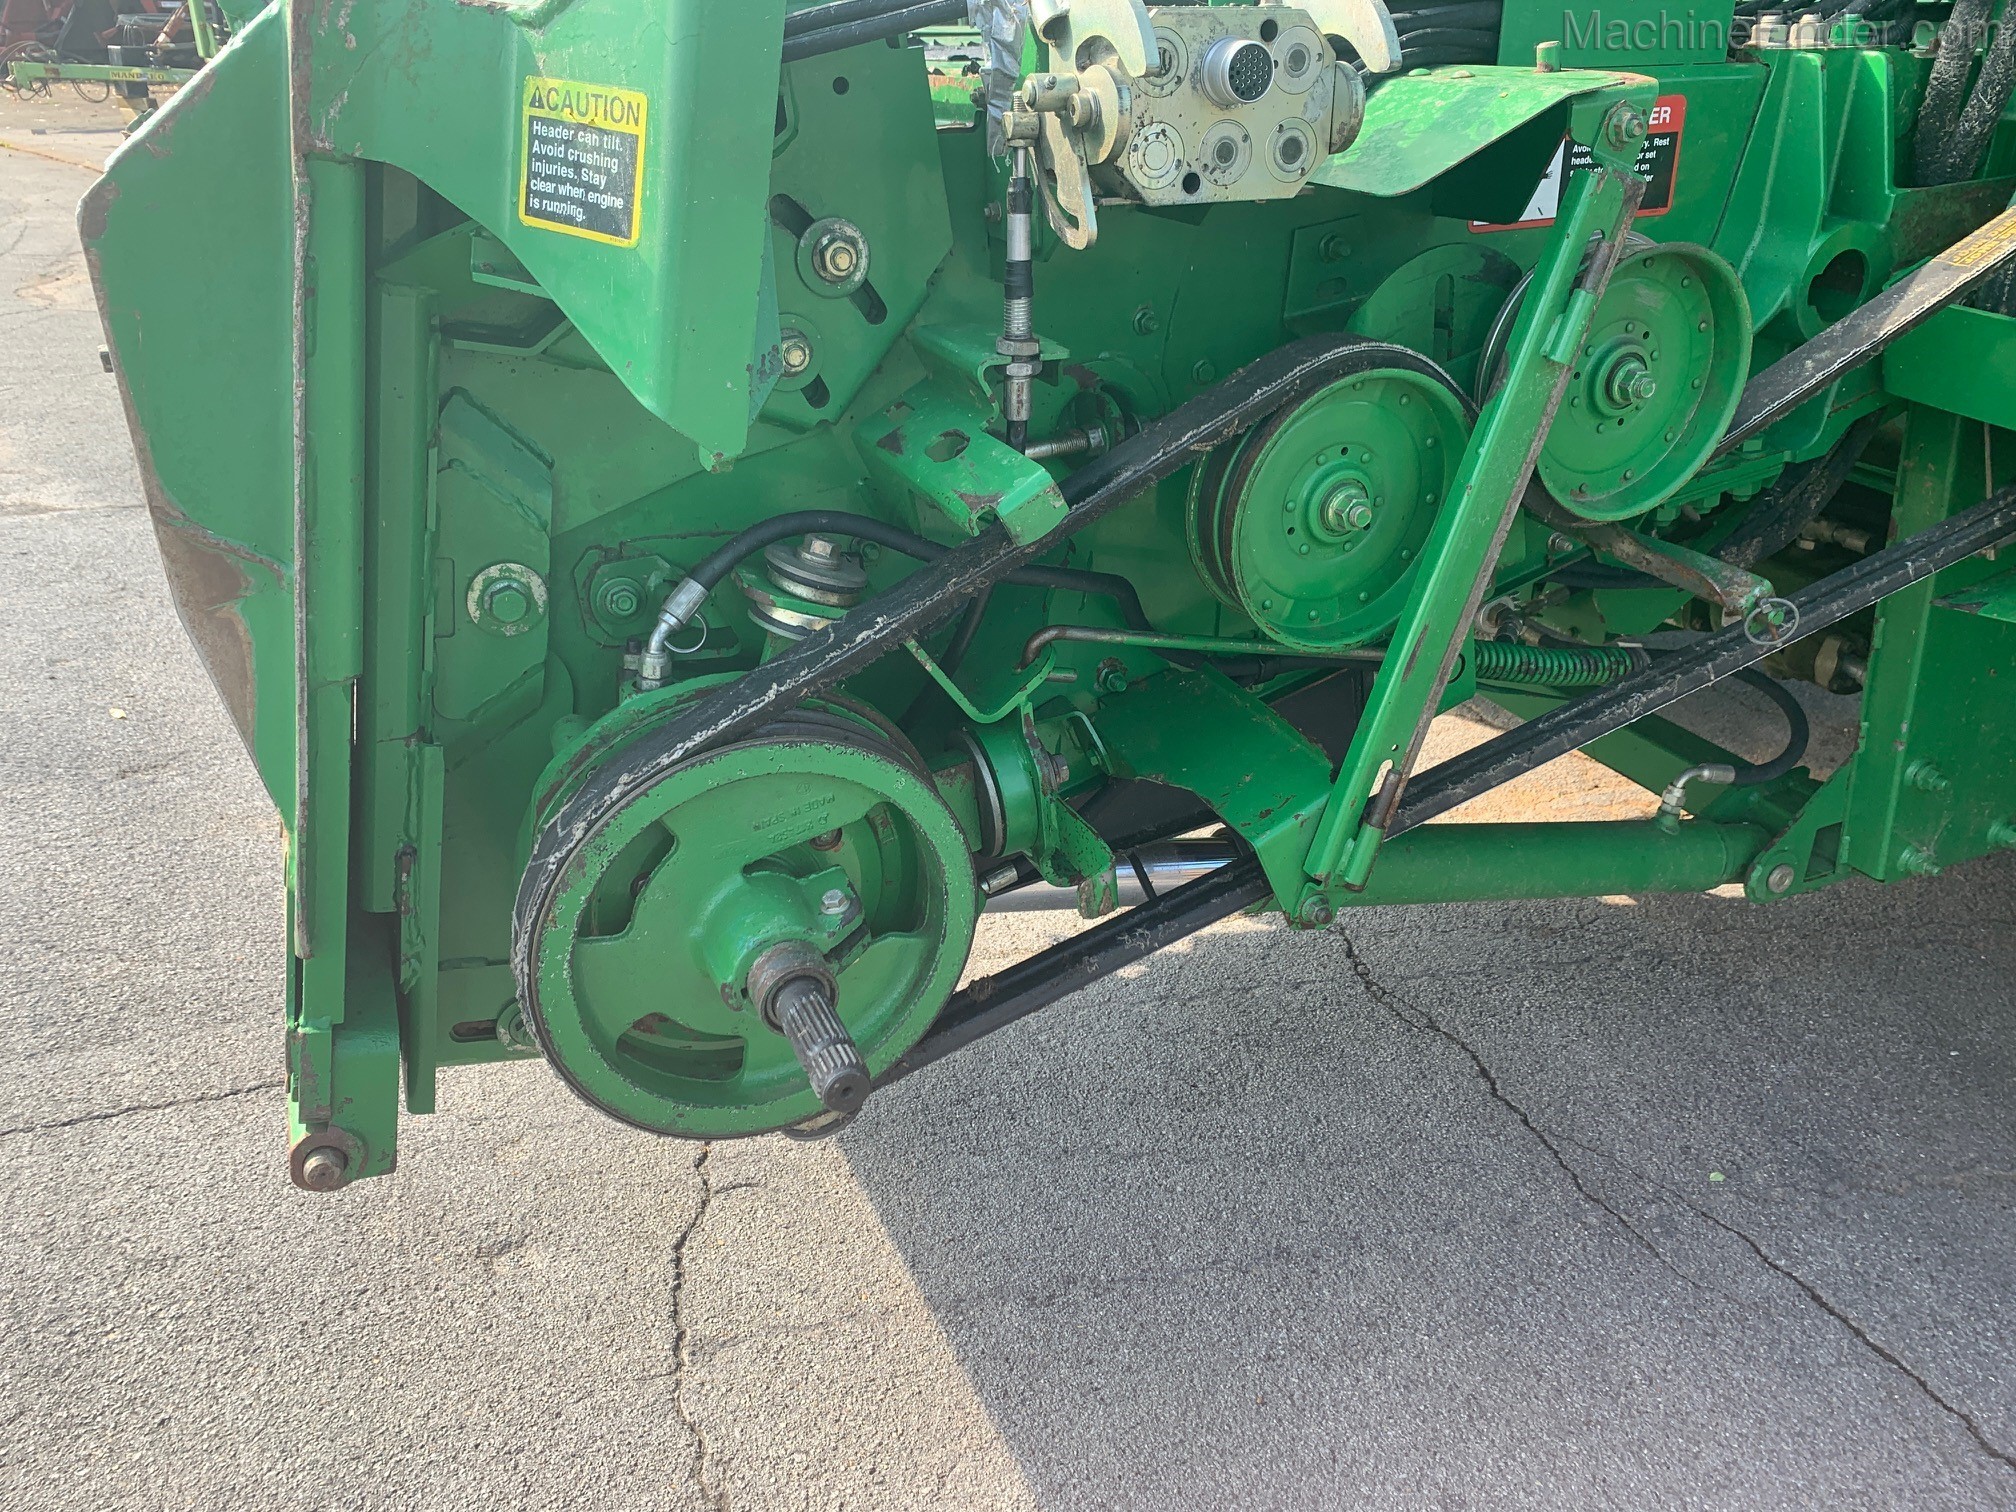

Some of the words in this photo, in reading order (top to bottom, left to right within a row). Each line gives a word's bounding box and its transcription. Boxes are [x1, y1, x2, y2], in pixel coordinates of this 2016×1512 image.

[546, 87, 641, 127] CAUTION
[533, 121, 574, 141] Header
[577, 131, 600, 147] can
[604, 133, 623, 151] tilt.
[1653, 137, 1670, 147] Rest
[532, 140, 565, 158] Avoid
[567, 147, 619, 174] crushing
[1645, 150, 1656, 159] set
[531, 158, 578, 179] injuries.
[581, 168, 607, 190] Stay
[529, 194, 540, 209] is
[542, 199, 586, 222] running.
[530, 178, 556, 193] clear
[558, 182, 585, 200] when
[588, 191, 624, 209] engine
